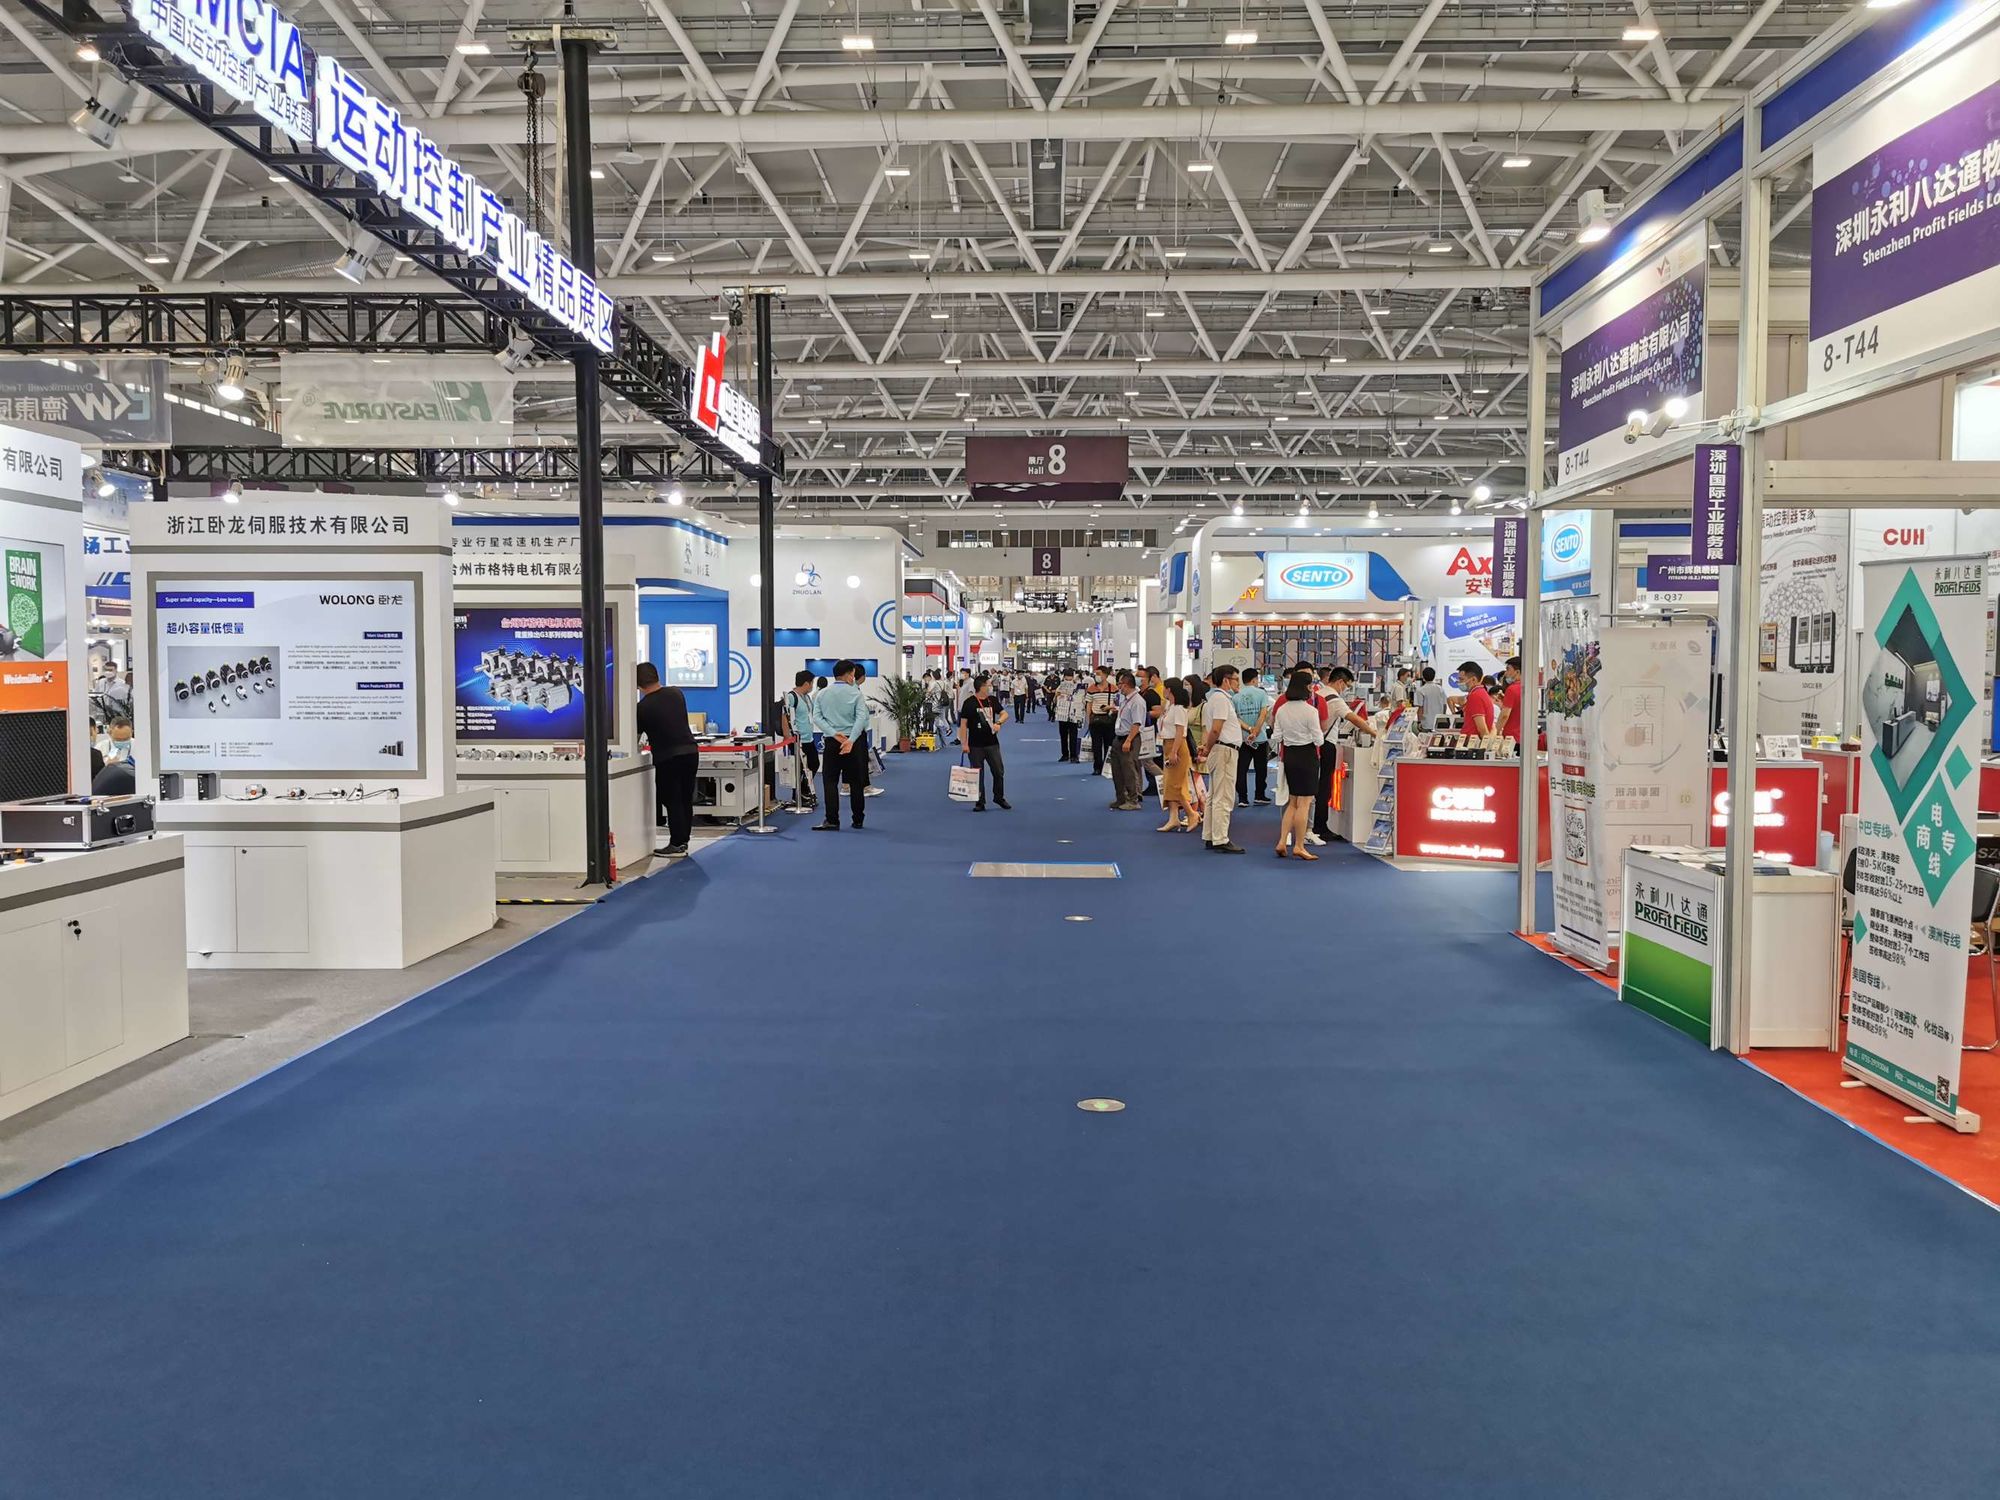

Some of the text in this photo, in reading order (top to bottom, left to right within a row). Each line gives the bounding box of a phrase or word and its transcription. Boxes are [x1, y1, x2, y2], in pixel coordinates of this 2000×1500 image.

[331, 60, 613, 349] 运动控制产业精品展区
[1863, 235, 1910, 267] Shenzhen
[1913, 215, 1946, 243] Profit
[1948, 199, 1984, 227] Fields
[1571, 312, 1690, 399] 深圳永利八达通物流有限公司
[1823, 325, 1880, 372] 8-T44
[1582, 392, 1602, 409] Shenzhen
[1602, 385, 1616, 399] Profit
[1615, 376, 1630, 392] Fields
[1630, 366, 1653, 385] Logistics
[2, 447, 63, 481] 有限公司
[1028, 466, 1044, 475] Hall
[1048, 444, 1066, 475] 8
[1564, 448, 1590, 474] 8-T44
[1706, 449, 1728, 560] 深圳国际工业服务展
[167, 515, 409, 535] 浙江卧龙伺服技术有限公司
[1555, 534, 1579, 554] SENTO
[1883, 528, 1925, 546] CUH
[9, 556, 37, 577] BRAIN
[1042, 553, 1052, 569] 8
[1502, 521, 1518, 597] 深圳国际工业服务展
[15, 576, 38, 592] WORK
[1292, 570, 1343, 583] SENTO
[319, 595, 375, 605] WOLONG
[1654, 593, 1683, 602] 8-Q37
[166, 622, 245, 634] 超小容量低惯量
[1635, 881, 1708, 923] 永利八达通
